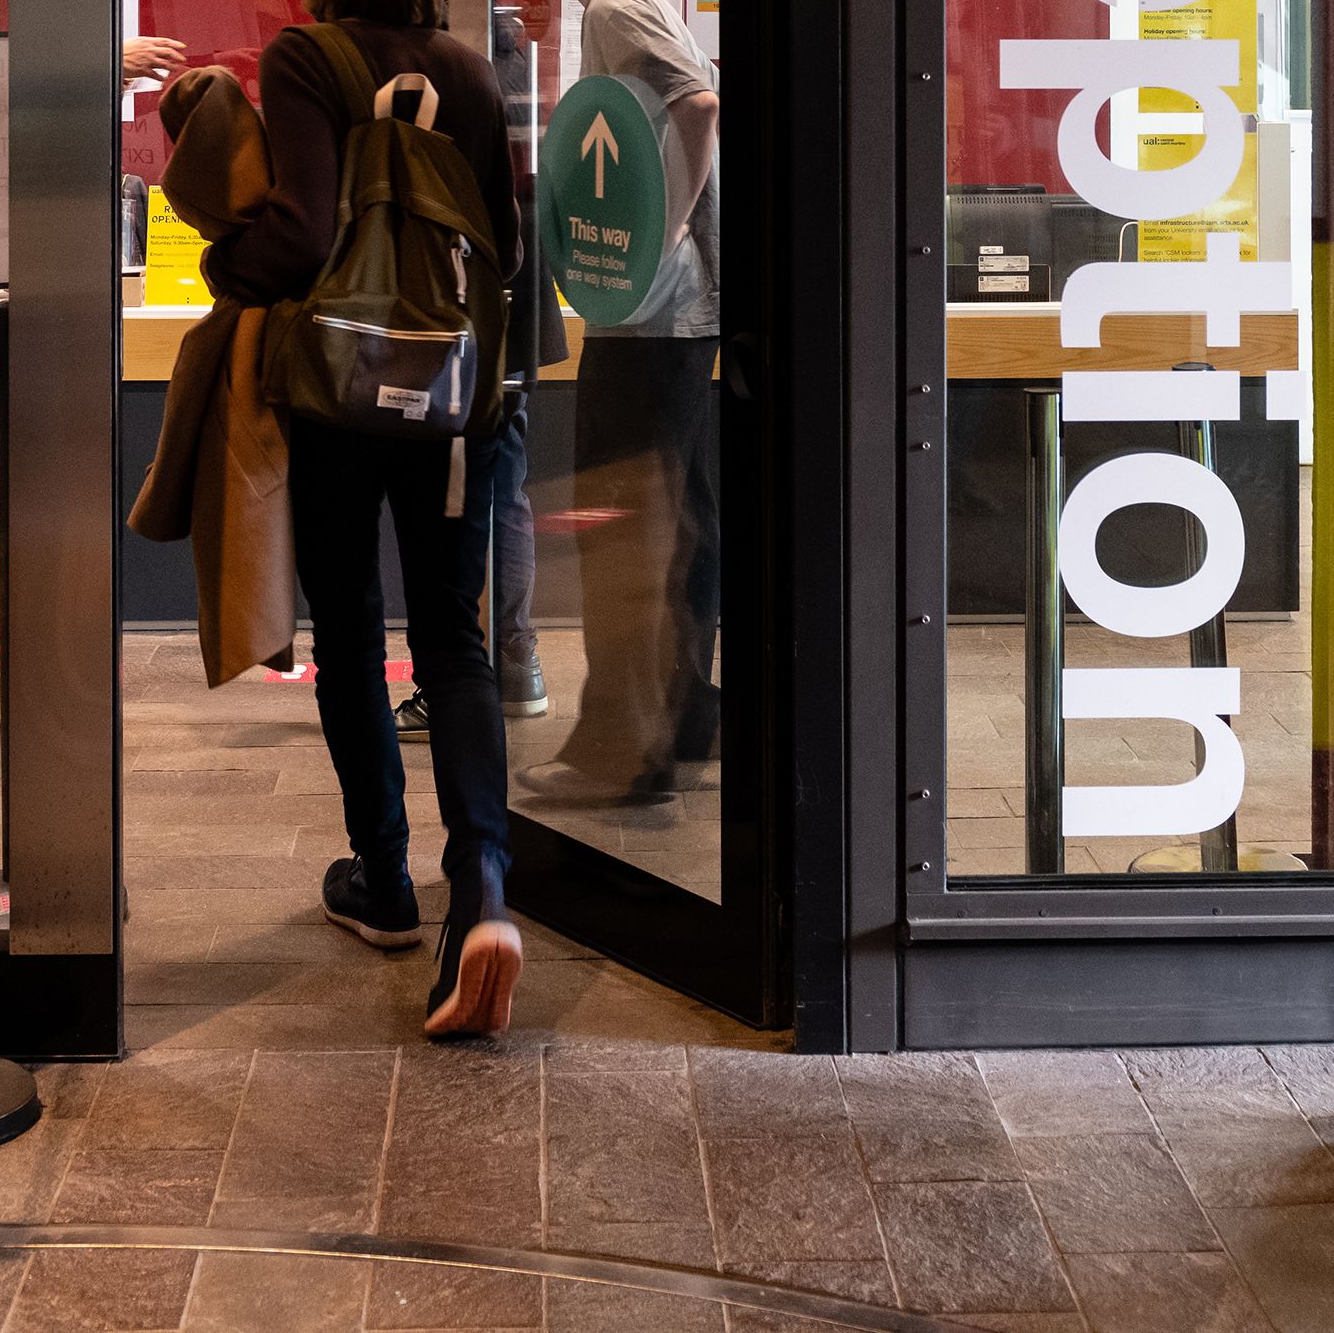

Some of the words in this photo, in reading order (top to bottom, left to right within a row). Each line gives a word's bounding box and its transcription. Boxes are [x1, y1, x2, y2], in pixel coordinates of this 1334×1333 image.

[569, 216, 598, 243] This
[602, 227, 631, 253] way
[572, 249, 600, 267] Please
[602, 254, 626, 272] follow
[566, 269, 582, 282] one
[584, 272, 601, 289] way
[602, 275, 633, 291] system
